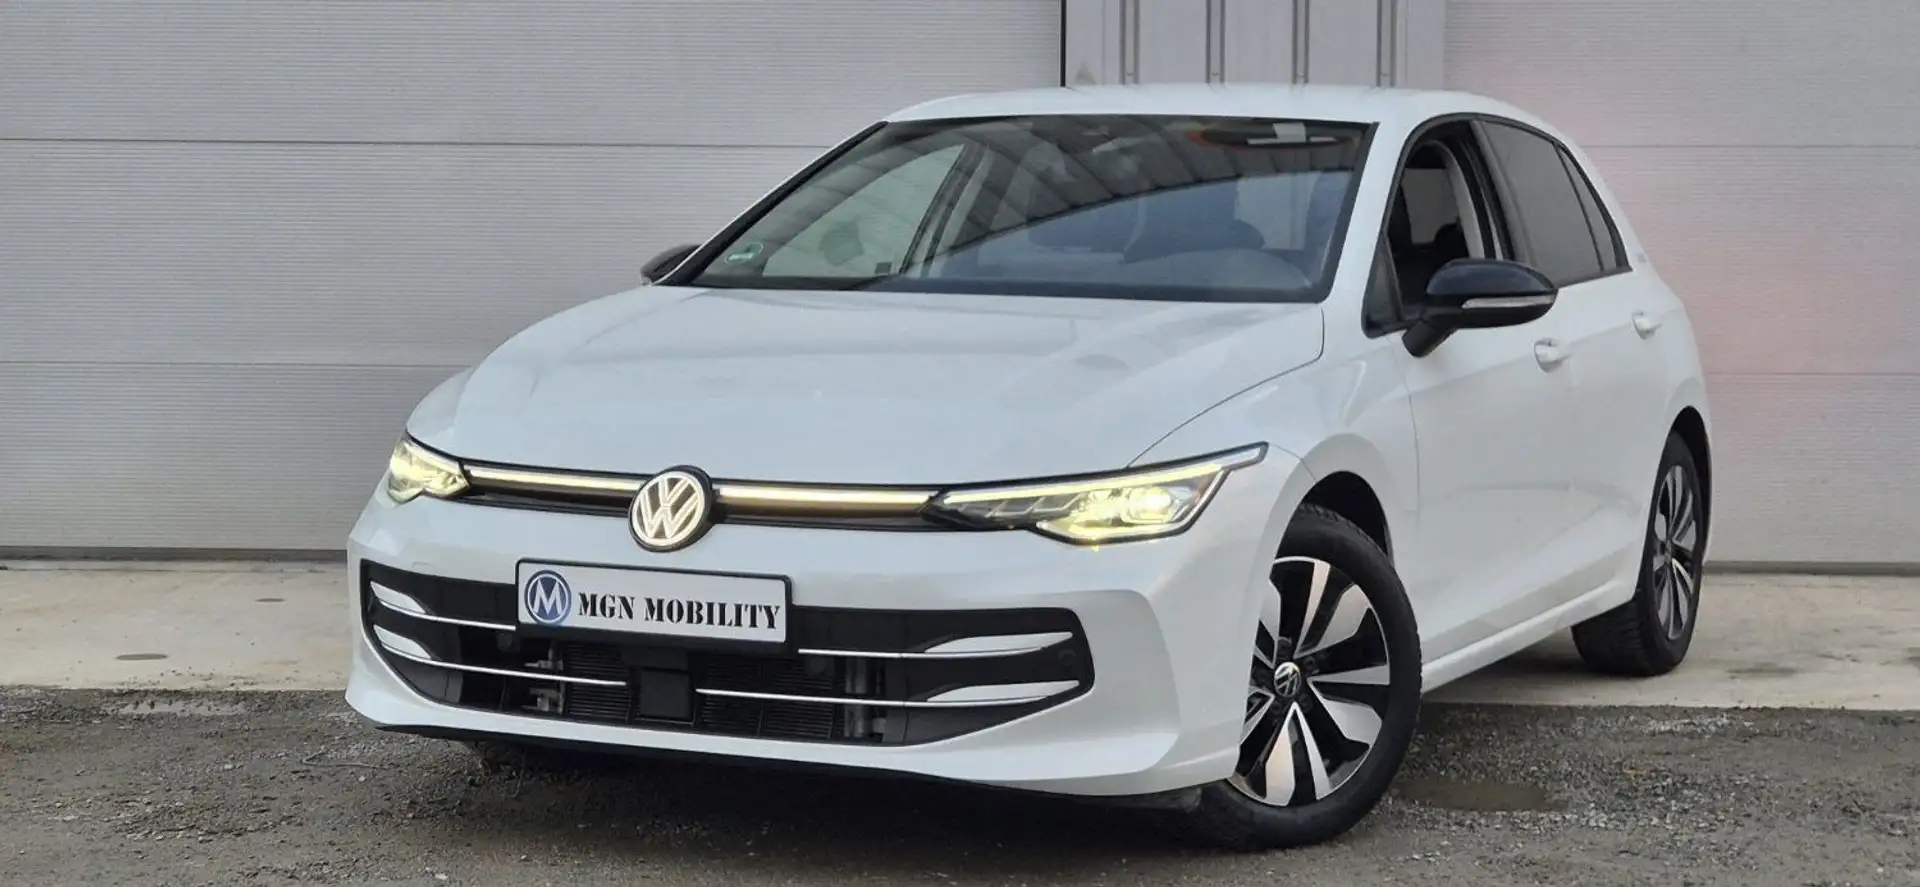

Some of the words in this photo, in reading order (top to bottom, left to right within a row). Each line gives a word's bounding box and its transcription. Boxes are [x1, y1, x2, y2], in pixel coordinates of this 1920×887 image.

[633, 475, 704, 546] VW
[530, 575, 566, 620] M
[578, 592, 636, 620] MGN
[645, 598, 780, 629] MOBILITY
